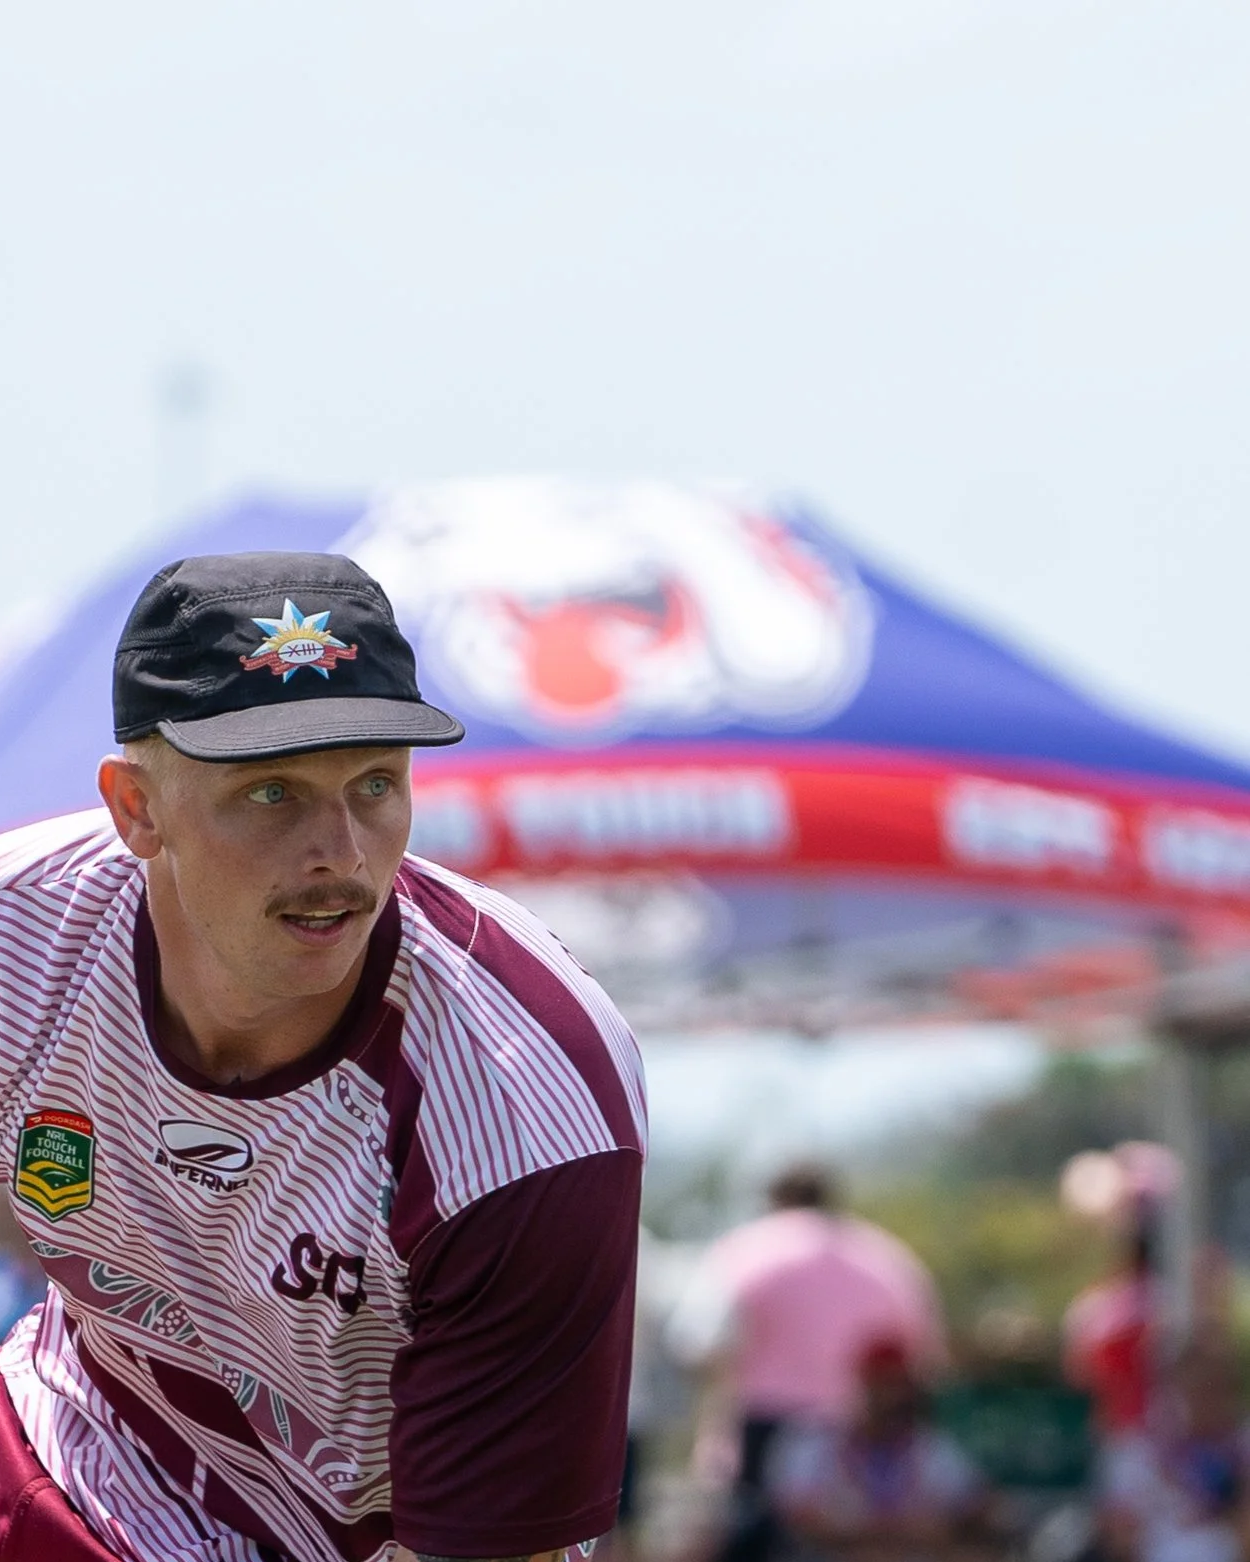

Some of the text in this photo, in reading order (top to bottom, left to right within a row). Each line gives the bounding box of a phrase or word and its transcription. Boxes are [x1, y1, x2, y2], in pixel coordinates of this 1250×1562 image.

[286, 642, 318, 658] XIII
[46, 1129, 69, 1143] NRL
[37, 1137, 78, 1156] TOUCH
[26, 1148, 86, 1170] FOOTBALL
